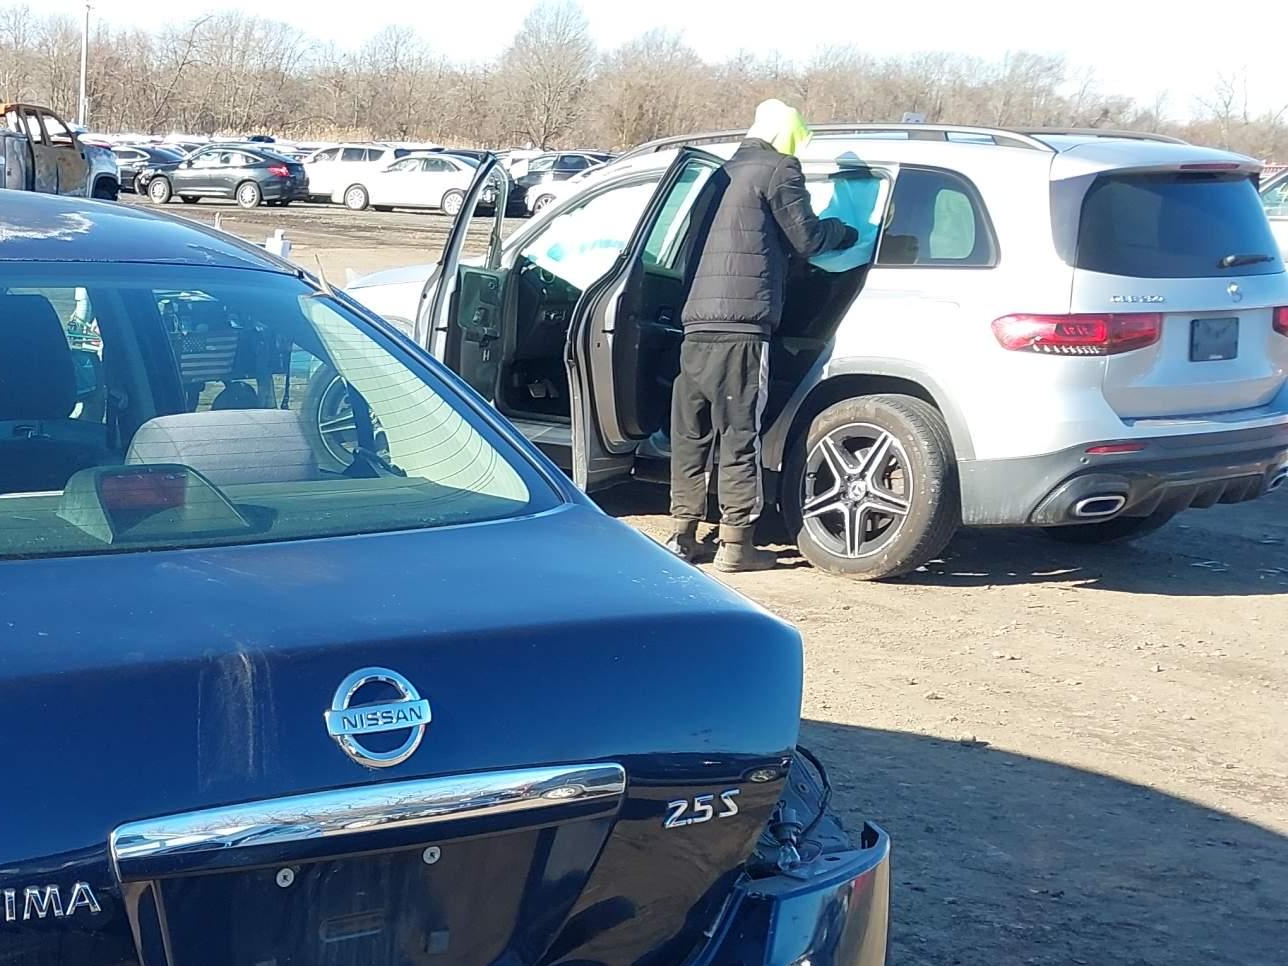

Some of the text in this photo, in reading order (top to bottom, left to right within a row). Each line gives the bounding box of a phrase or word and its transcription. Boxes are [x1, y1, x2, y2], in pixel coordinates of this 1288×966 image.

[342, 705, 423, 731] NISSAN
[665, 788, 740, 829] 2.5 S
